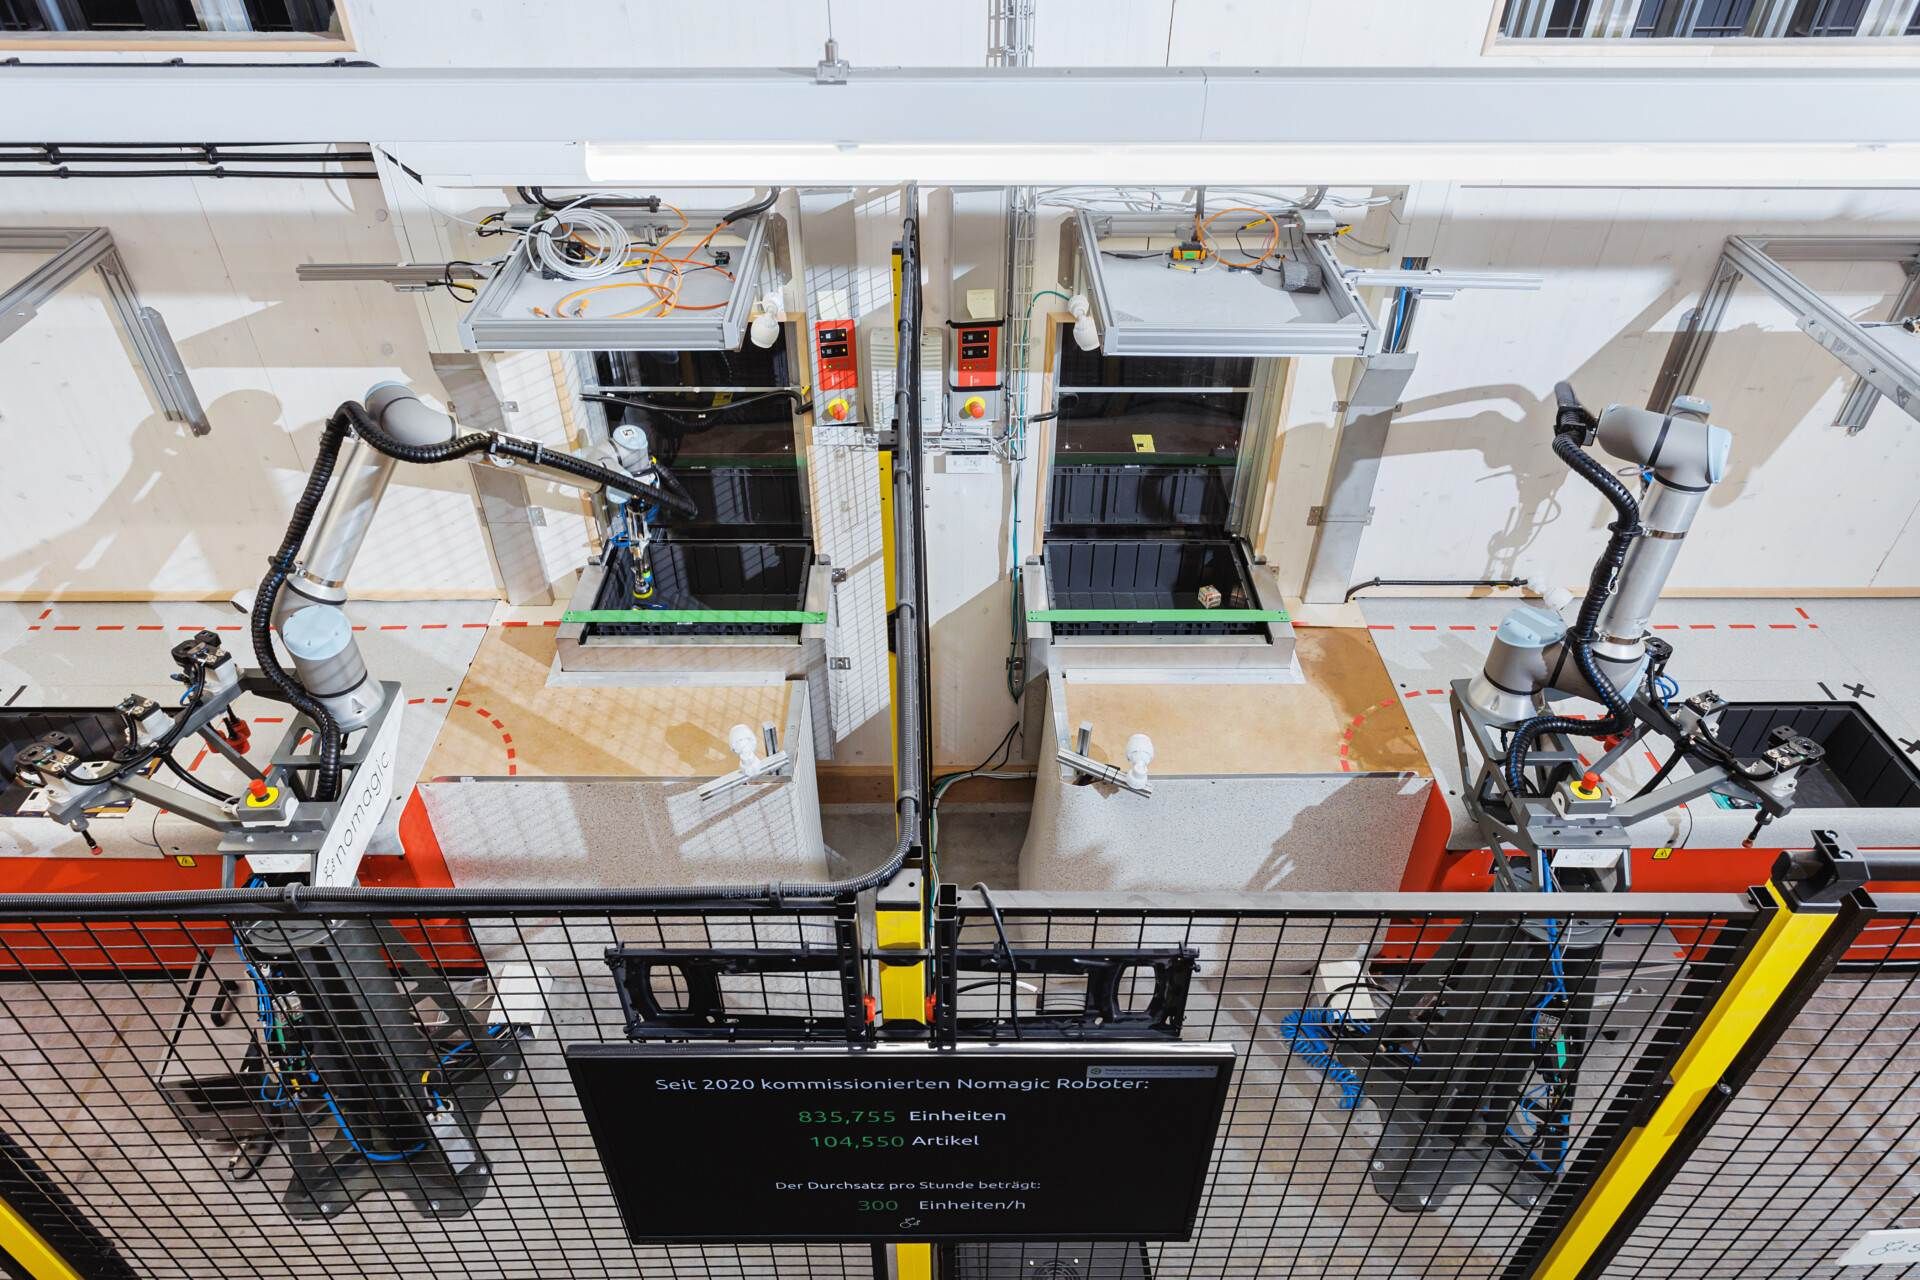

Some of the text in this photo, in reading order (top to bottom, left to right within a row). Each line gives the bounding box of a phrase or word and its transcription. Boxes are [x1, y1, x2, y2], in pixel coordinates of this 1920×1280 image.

[335, 751, 391, 865] nomagic
[655, 1076, 1150, 1092] Seit 2020 kommissionierten Nomagic Roboter:
[798, 1109, 1007, 1125] 835,755 Einheiten
[810, 1135, 981, 1149] 104,550 Artikel
[775, 1179, 1042, 1192] Der Durchsatz pro Stunde beträgt:
[858, 1198, 1026, 1212] 300 Einheiten/h
